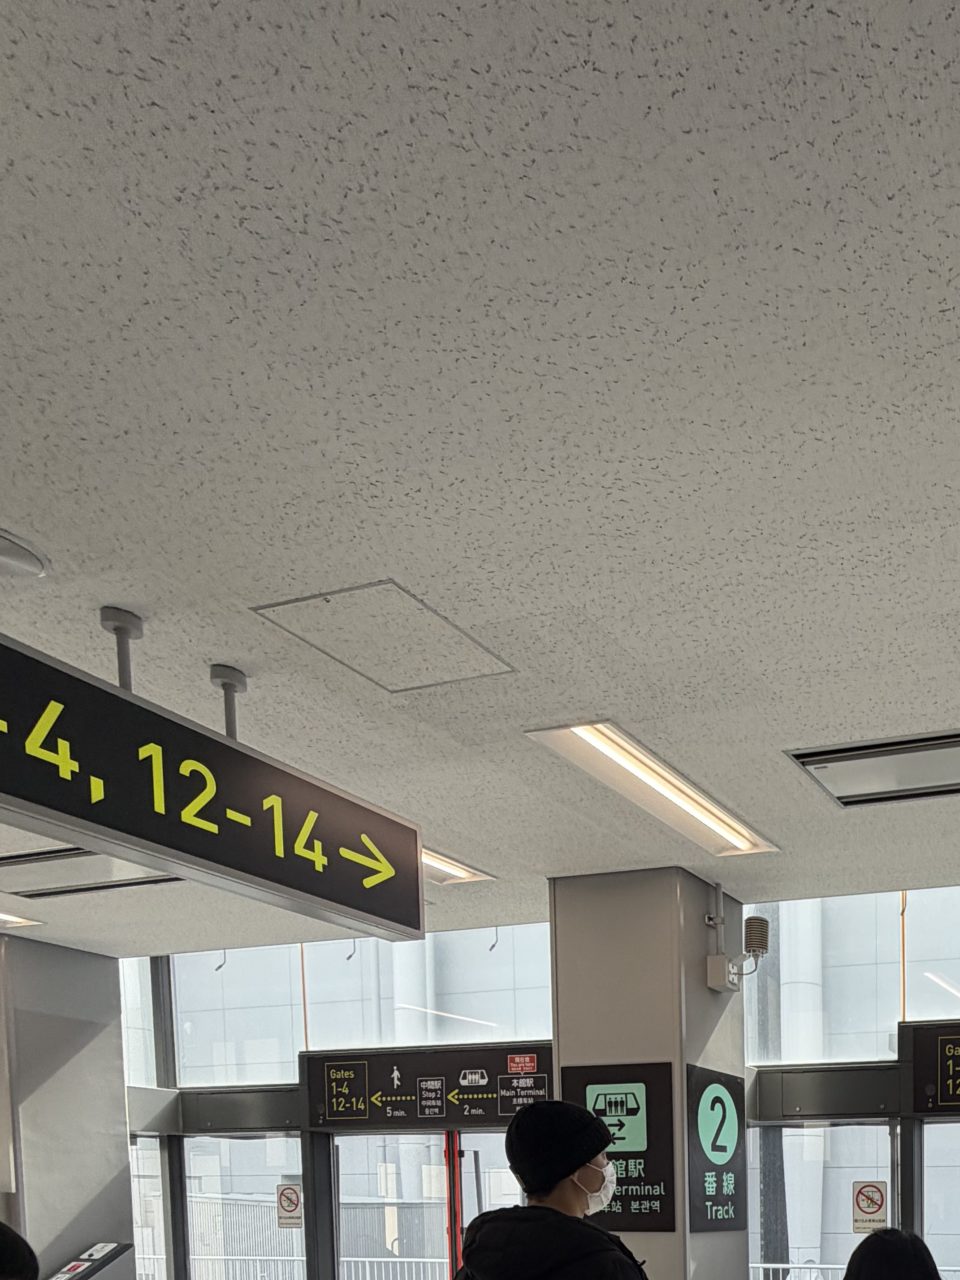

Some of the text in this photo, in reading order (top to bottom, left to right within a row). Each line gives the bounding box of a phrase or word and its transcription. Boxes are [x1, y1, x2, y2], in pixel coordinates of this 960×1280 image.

[0, 700, 328, 873] 4, 12-14
[330, 1069, 355, 1079] Gates
[331, 1081, 350, 1095] 1-4
[436, 1090, 441, 1098] 2
[500, 1087, 546, 1096] Main Terminal
[331, 1097, 365, 1111] 12-14
[463, 1104, 486, 1115] 2 min.
[386, 1106, 392, 1117] 5
[710, 1096, 728, 1153] 2
[611, 1159, 645, 1178] 館駅
[614, 1181, 665, 1196] erminal
[705, 1201, 735, 1220] Track
